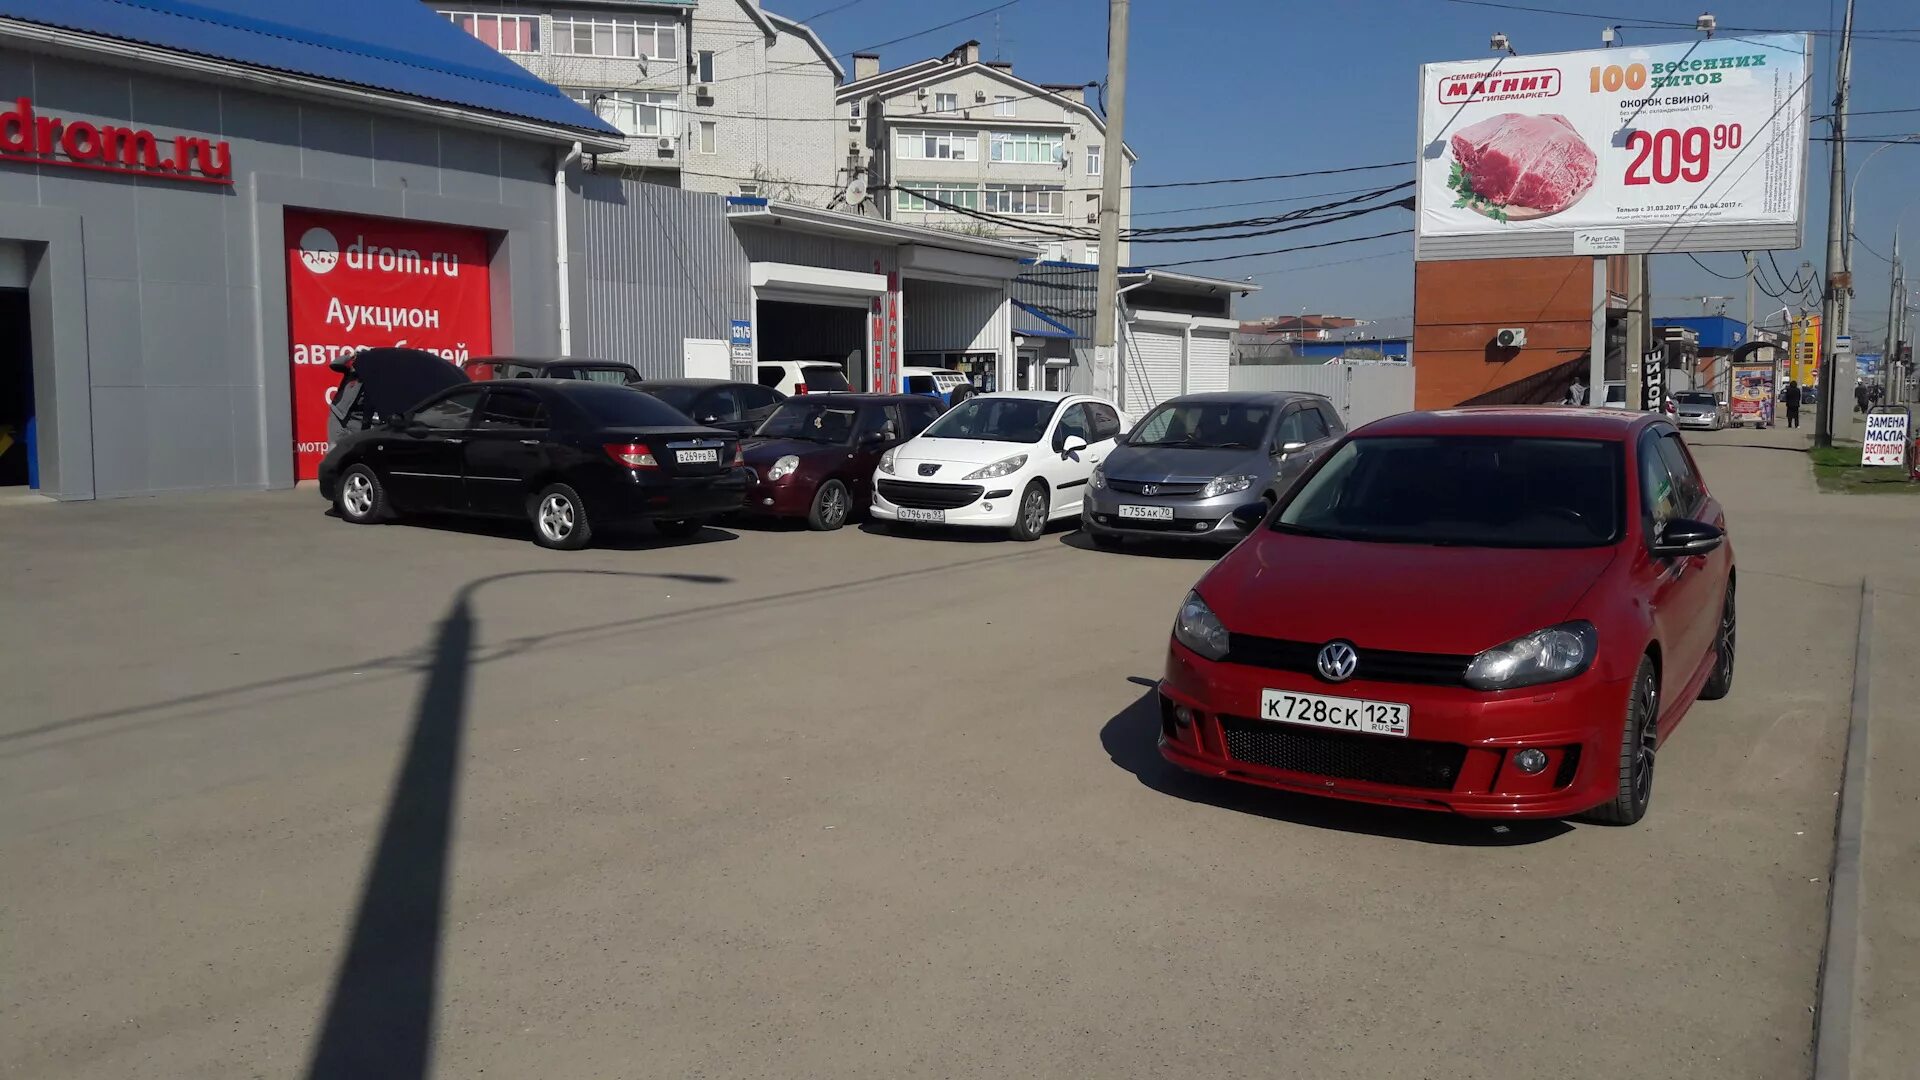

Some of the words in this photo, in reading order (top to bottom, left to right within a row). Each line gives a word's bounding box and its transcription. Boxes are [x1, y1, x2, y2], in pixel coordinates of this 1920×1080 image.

[1651, 54, 1766, 75] весенних
[1451, 69, 1502, 81] СЕМЕЙНЫЙ
[1589, 63, 1647, 93] 100
[1651, 72, 1722, 89] хитов
[1447, 75, 1553, 97] МАГНИТ
[1481, 91, 1549, 103] ГИПЕРМАРКЕТ
[1620, 98, 1662, 109] ОКОРОК
[1665, 92, 1710, 105] СВИНОЙ
[0, 97, 230, 176] drom.ru
[1624, 126, 1711, 186] 209
[1713, 123, 1742, 150] 90
[1646, 204, 1681, 212] 31.03.2017
[346, 235, 459, 277] drom.ru
[326, 297, 440, 332] Аукцион
[732, 325, 751, 339] 131/5
[1868, 416, 1905, 428] ЗАМЕНА
[1866, 429, 1904, 442] МАСЛА
[1864, 443, 1903, 455] БЕСПЛАТНО
[1268, 695, 1359, 727] К728СК
[1365, 704, 1402, 725] 123
[1371, 723, 1390, 732] RUS
